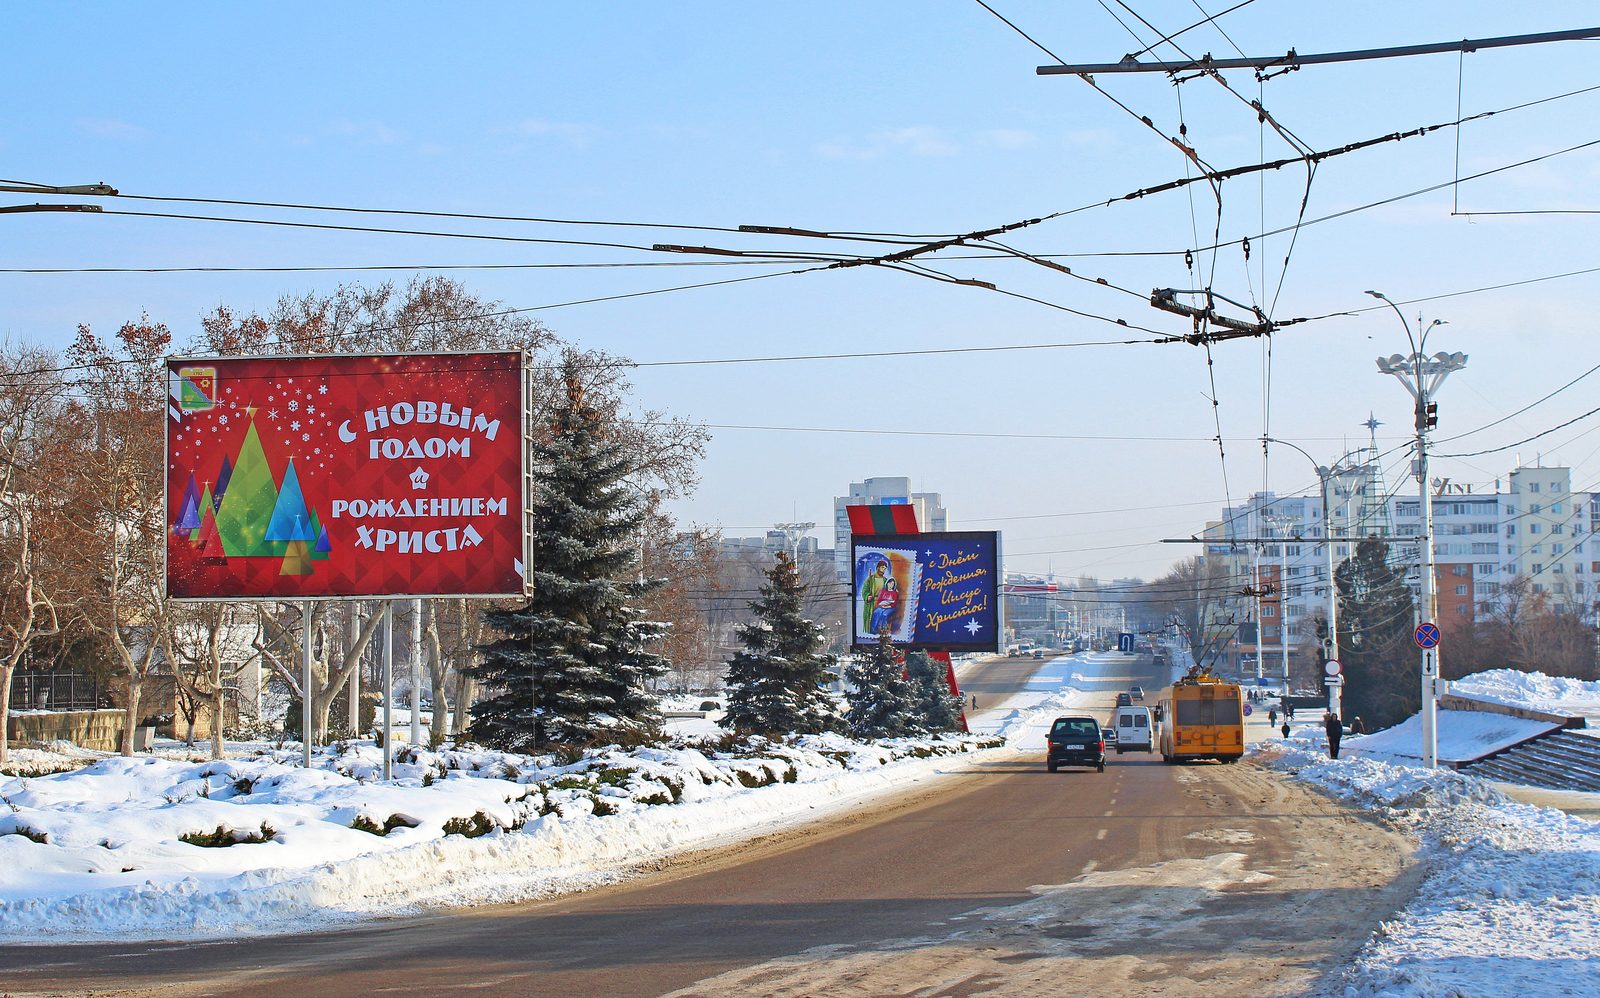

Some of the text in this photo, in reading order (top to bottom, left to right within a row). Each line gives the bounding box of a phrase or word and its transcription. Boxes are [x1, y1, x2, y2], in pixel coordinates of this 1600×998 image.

[364, 401, 501, 441] НОВЫМ
[369, 437, 471, 459] ГОДОМ
[414, 475, 428, 484] и
[1430, 477, 1473, 497] VINT
[332, 496, 508, 518] РОЖДЕНИЕМ
[354, 523, 484, 555] ХРИСТА
[937, 550, 979, 569] Днём
[923, 568, 987, 593] Рождения,
[941, 587, 981, 606] Иисус
[925, 594, 987, 632] Христос!
